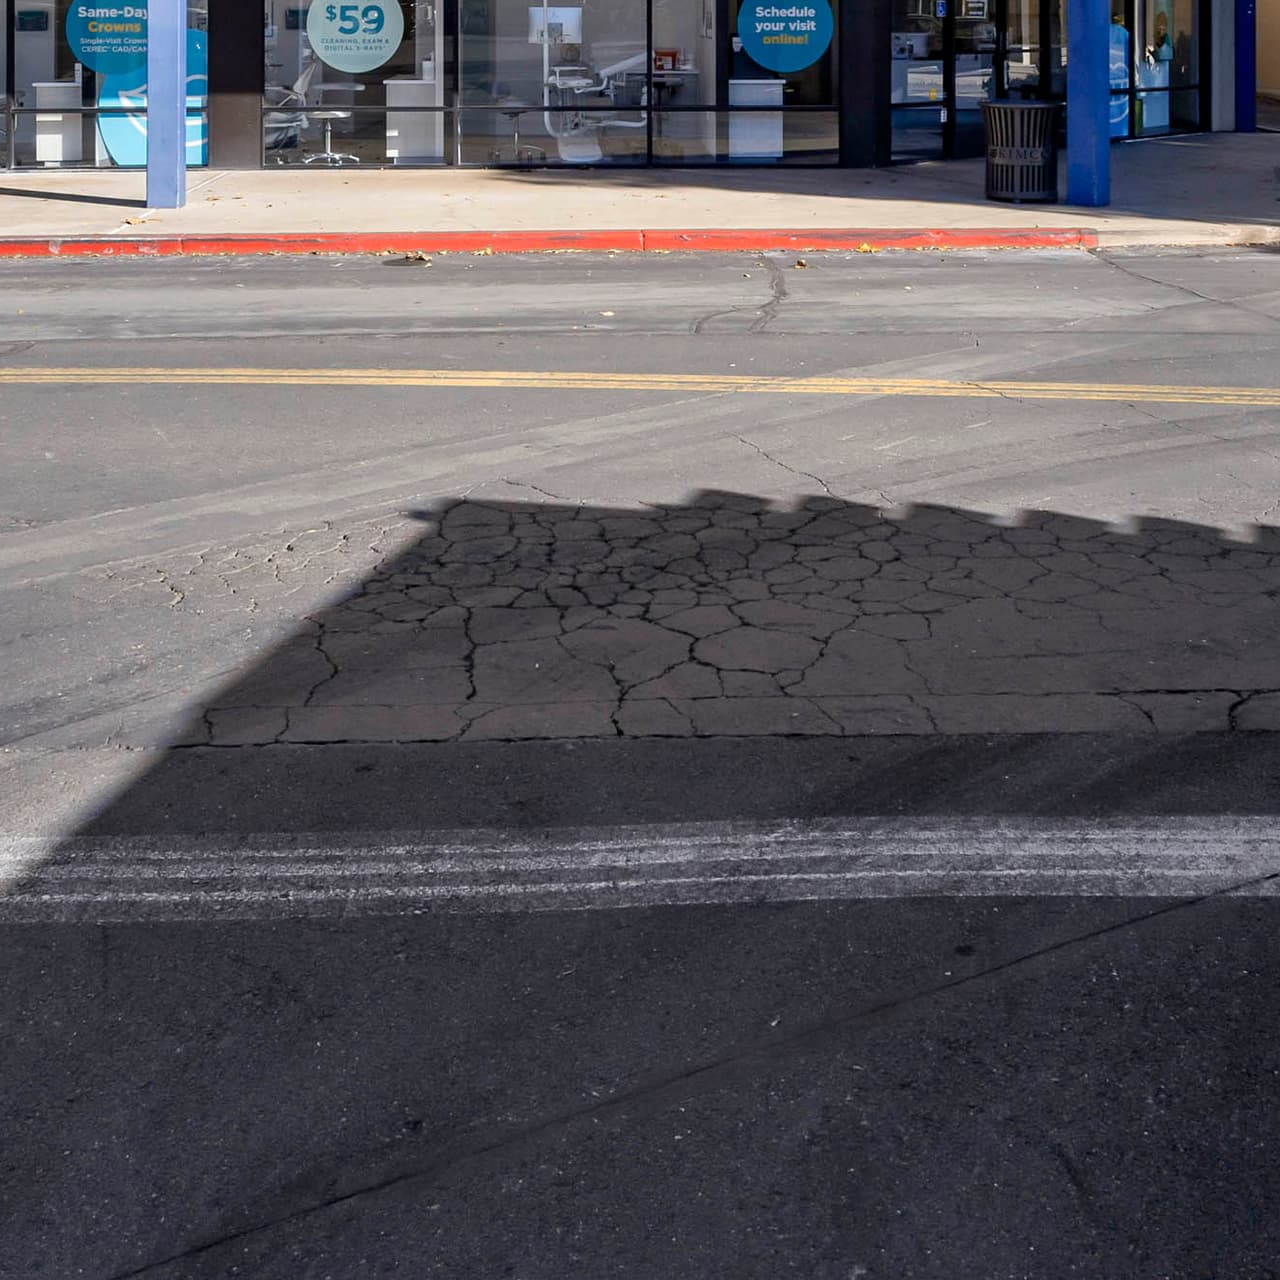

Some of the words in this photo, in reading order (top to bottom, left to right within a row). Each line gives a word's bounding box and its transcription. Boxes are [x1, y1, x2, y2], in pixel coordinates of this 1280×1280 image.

[77, 6, 148, 19] Same-Day
[755, 6, 816, 17] Schedule
[325, 4, 385, 35] $59
[87, 21, 142, 33] Crowns
[755, 21, 786, 33] your
[788, 20, 816, 31] visit
[80, 37, 122, 45] Single-Visit
[762, 33, 809, 44] online!
